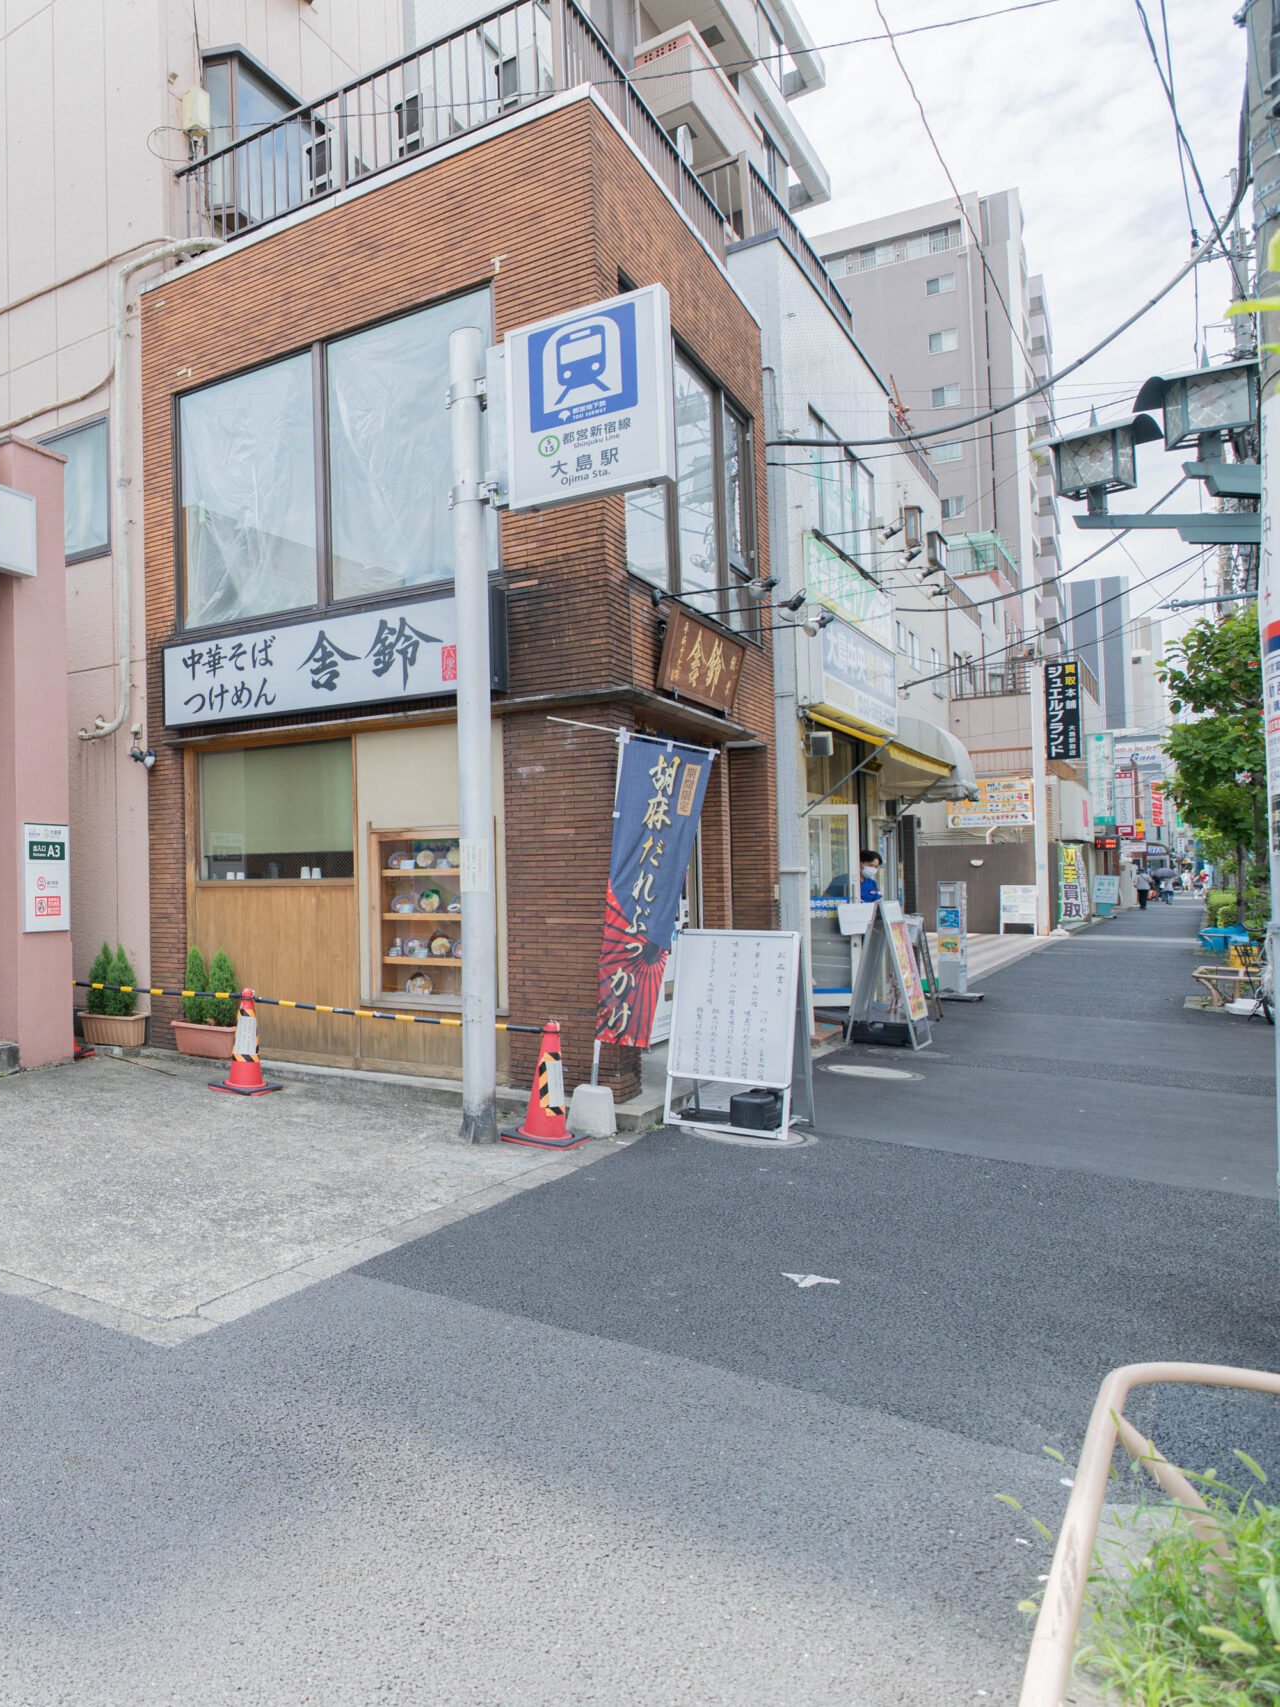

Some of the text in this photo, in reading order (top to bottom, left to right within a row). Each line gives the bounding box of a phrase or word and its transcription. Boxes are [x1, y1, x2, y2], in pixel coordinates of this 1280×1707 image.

[562, 418, 631, 446] 都営新宿線
[573, 432, 621, 449] Shinjuku Line
[544, 444, 555, 453] 15
[551, 447, 619, 479] 大島駅
[560, 468, 611, 486] Ojima Sta.
[181, 635, 276, 681] 中華そば
[296, 616, 444, 692] 舎鈴
[183, 677, 277, 714] つけめん
[1047, 665, 1064, 758] ジュエルブランド
[47, 844, 61, 858] A3
[607, 754, 681, 1036] 胡麻だれぶっかけ
